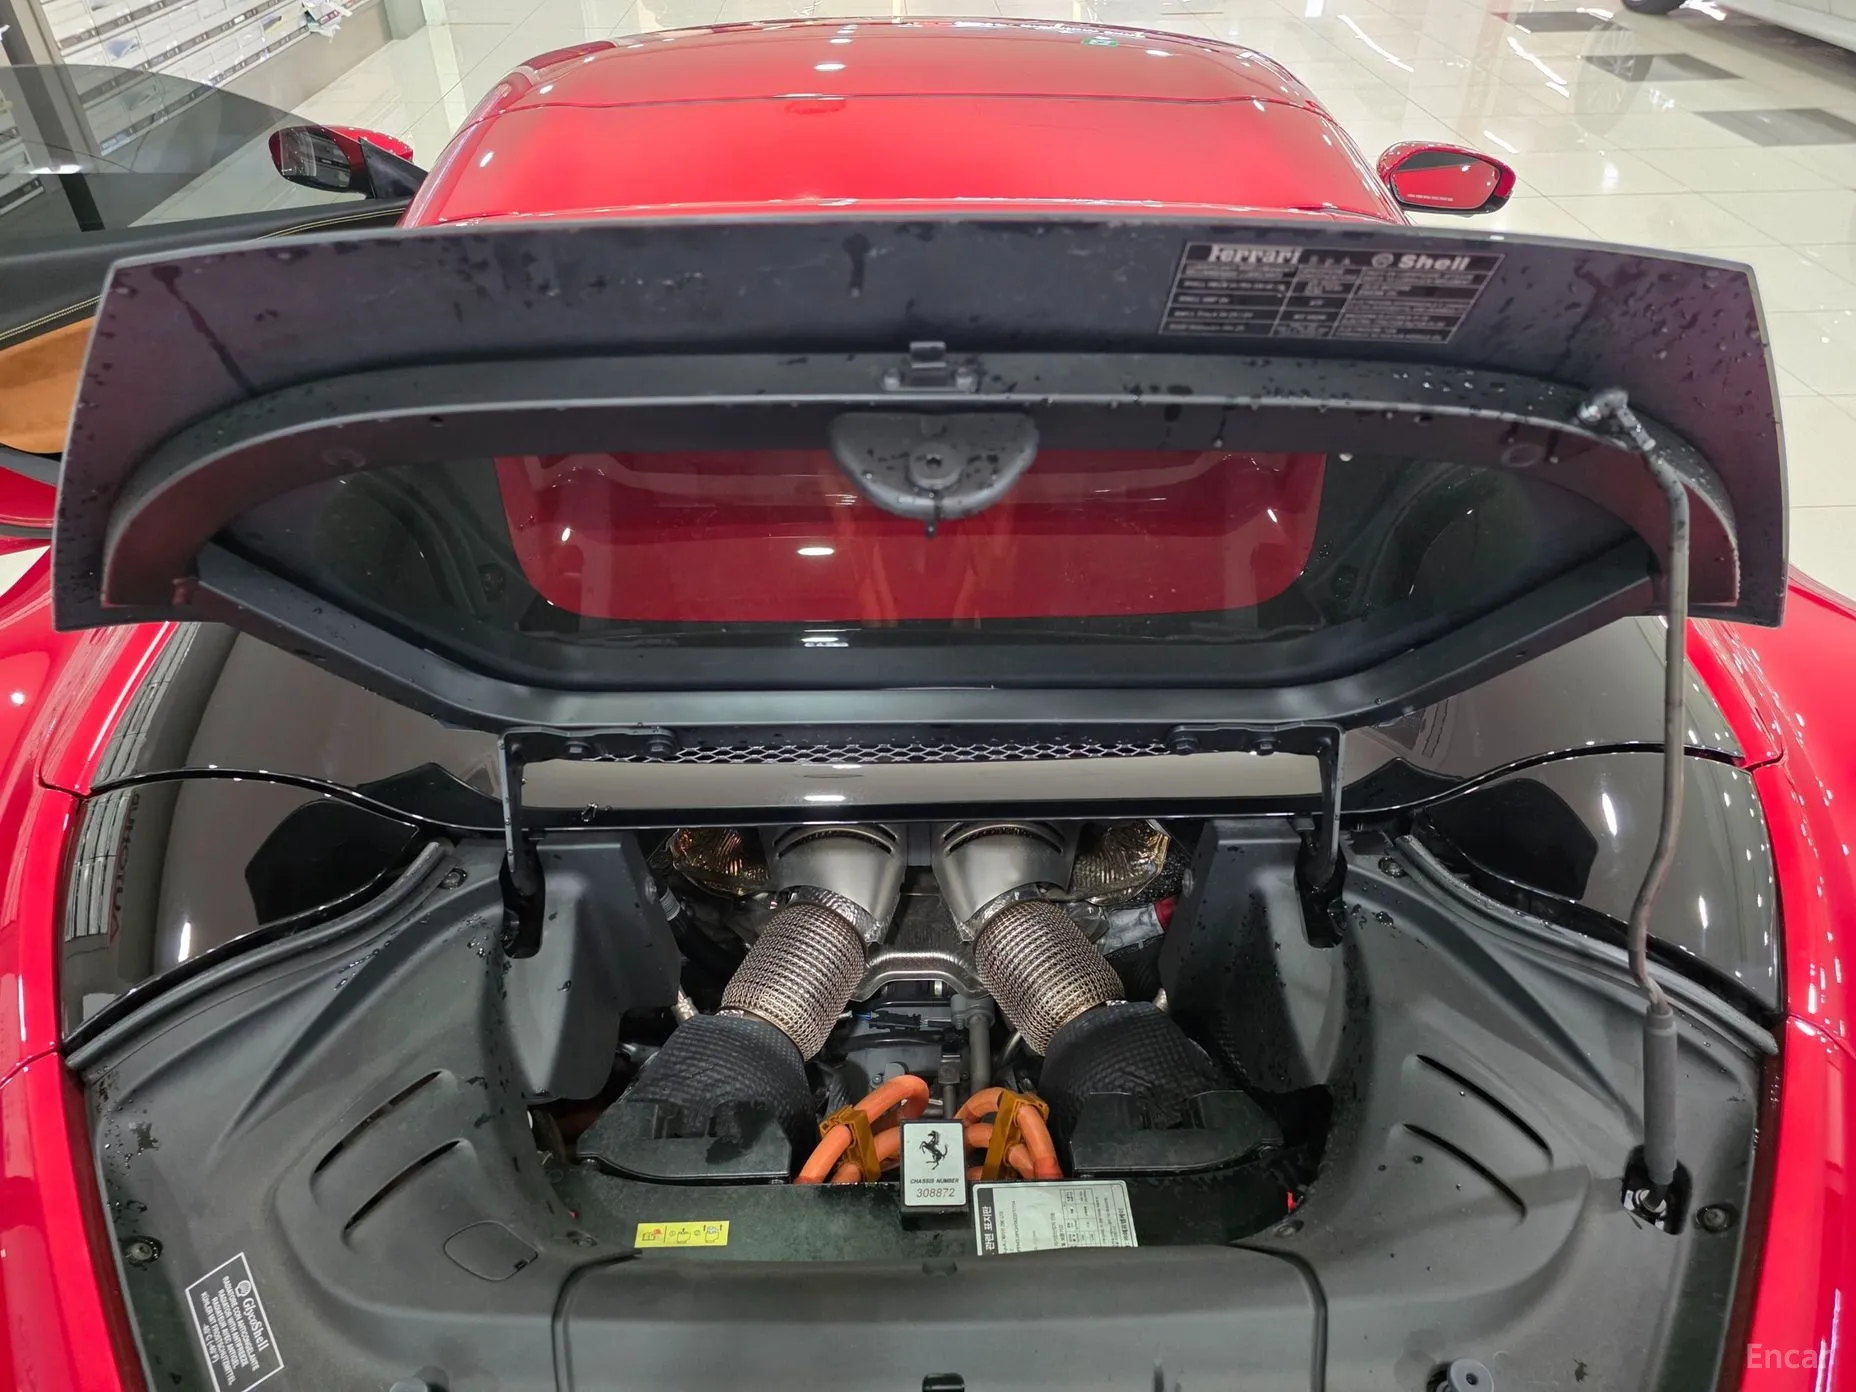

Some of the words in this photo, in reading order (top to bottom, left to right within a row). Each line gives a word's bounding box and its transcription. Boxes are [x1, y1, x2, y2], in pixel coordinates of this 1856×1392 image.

[1208, 244, 1302, 265] Ferrari
[1398, 254, 1472, 271] Shell
[916, 1187, 955, 1198] 308872
[982, 1206, 993, 1231] 표지판
[984, 1233, 995, 1251] 관련
[218, 1288, 233, 1319] RADIATOR
[222, 1275, 238, 1308] RADIATORE
[232, 1306, 242, 1321] CON
[211, 1296, 227, 1330] RADIATEUR
[221, 1328, 232, 1344] AVEC
[227, 1343, 240, 1370] ANTIGEL
[227, 1317, 237, 1333] WITH
[243, 1297, 270, 1352] GlycoShell
[231, 1331, 249, 1368] ANTIFREEZE
